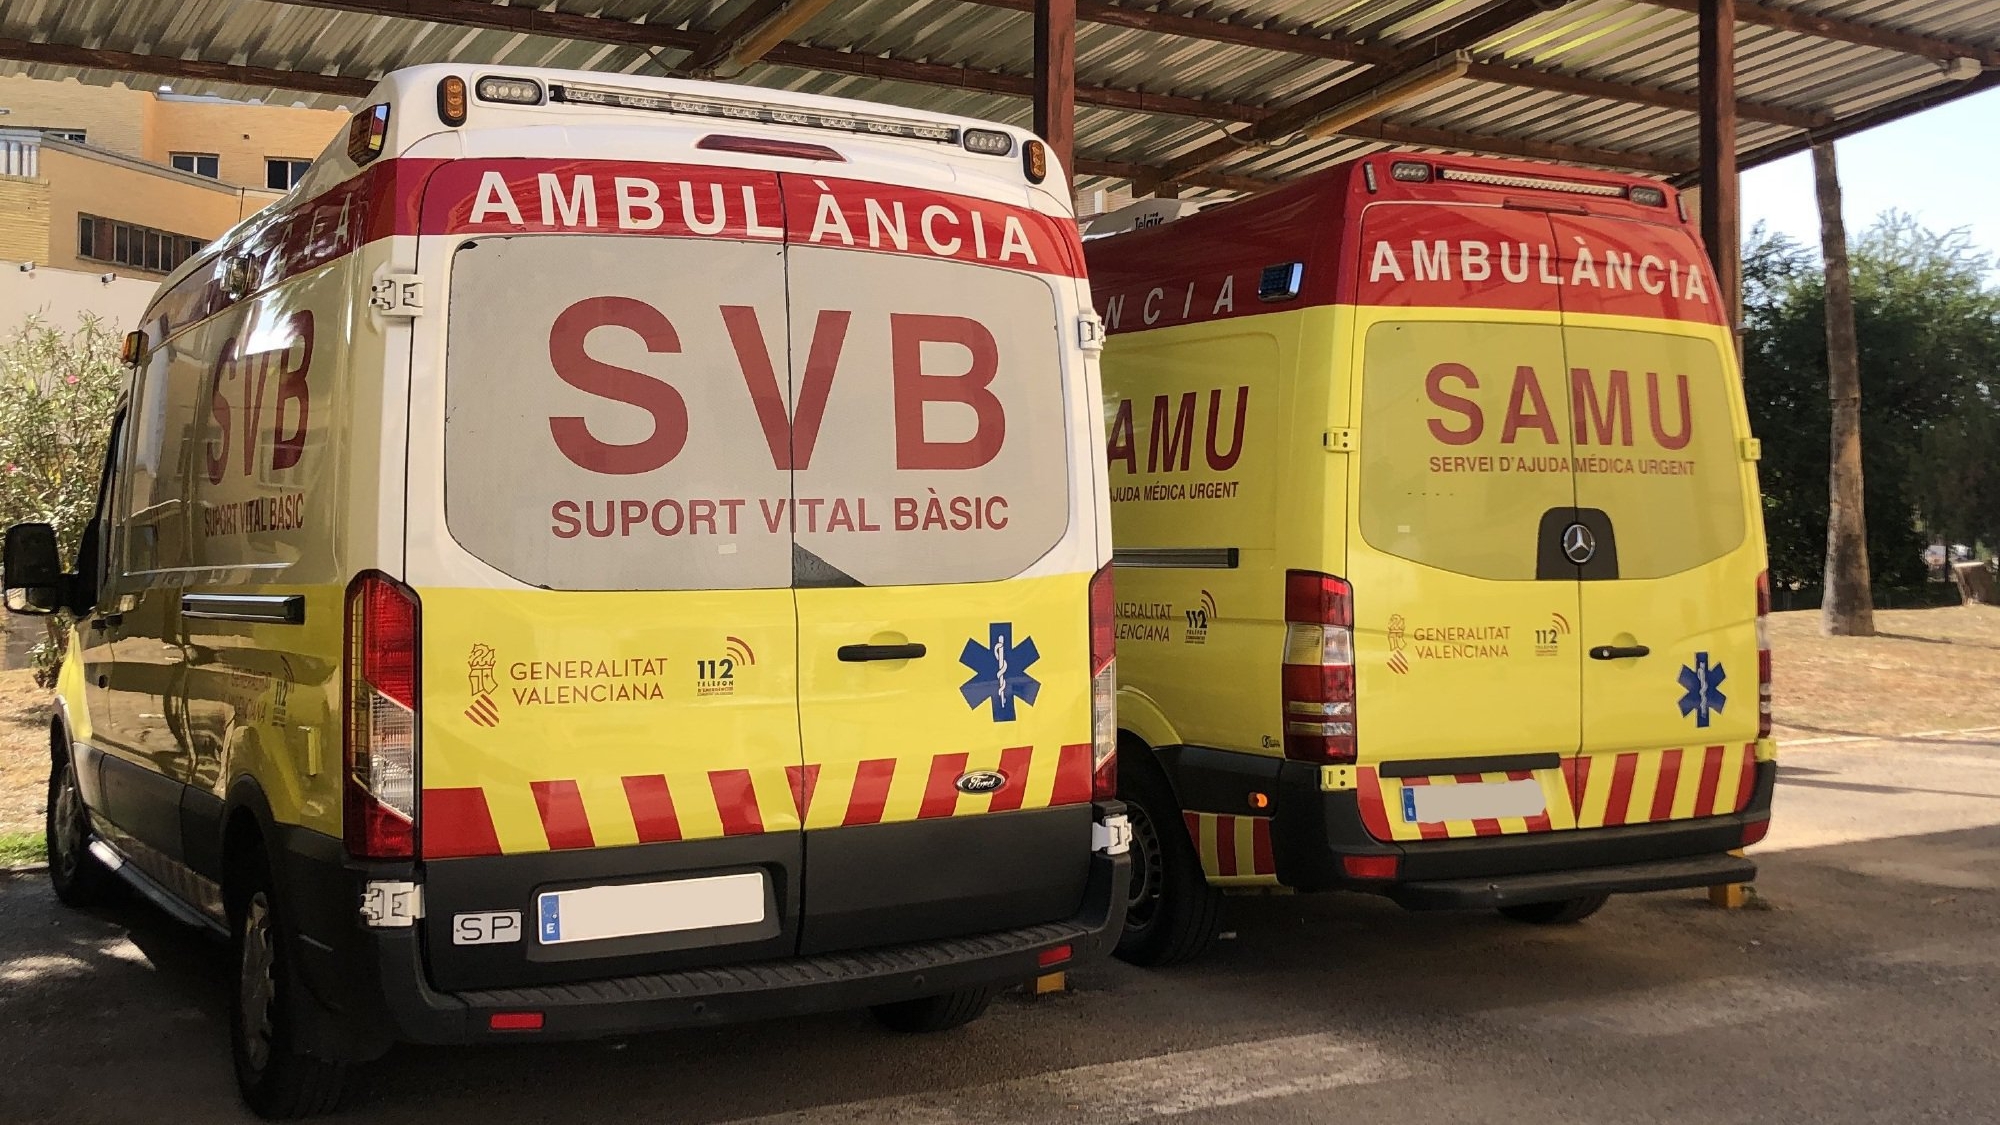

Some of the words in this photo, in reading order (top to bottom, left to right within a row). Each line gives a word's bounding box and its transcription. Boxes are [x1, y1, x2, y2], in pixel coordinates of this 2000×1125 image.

[469, 171, 1039, 265] AMBULÀNCIA
[1369, 236, 1709, 304] AMBULÀNCIA
[548, 295, 1006, 475] SVB
[207, 310, 314, 485] SVB
[1425, 362, 1692, 450] SAMU
[1106, 386, 1249, 475] AMU
[1429, 456, 1493, 472] SERVEI
[1499, 456, 1570, 472] D'AJUDA
[1574, 454, 1634, 475] MÉDICA
[1638, 460, 1695, 476] URGENT
[1144, 481, 1185, 501] MÉDICA
[1189, 481, 1239, 499] URGENT
[204, 502, 237, 537] SUPORT
[240, 499, 267, 534] VITAL
[270, 487, 304, 531] BÀSIC
[551, 498, 745, 539] SUPORT
[760, 497, 880, 533] VITAL
[894, 488, 1009, 532] BÀSIC
[1186, 610, 1207, 628] 112
[1414, 626, 1511, 641] GENERALITAT
[1535, 629, 1557, 644] 112
[1415, 645, 1509, 659] VALENCIANA
[510, 658, 667, 681] GENERALITAT
[697, 658, 733, 679] 112
[512, 683, 664, 706] VALENCIANA
[968, 774, 995, 790] Ford
[460, 915, 514, 941] SP
[546, 922, 556, 934] E
